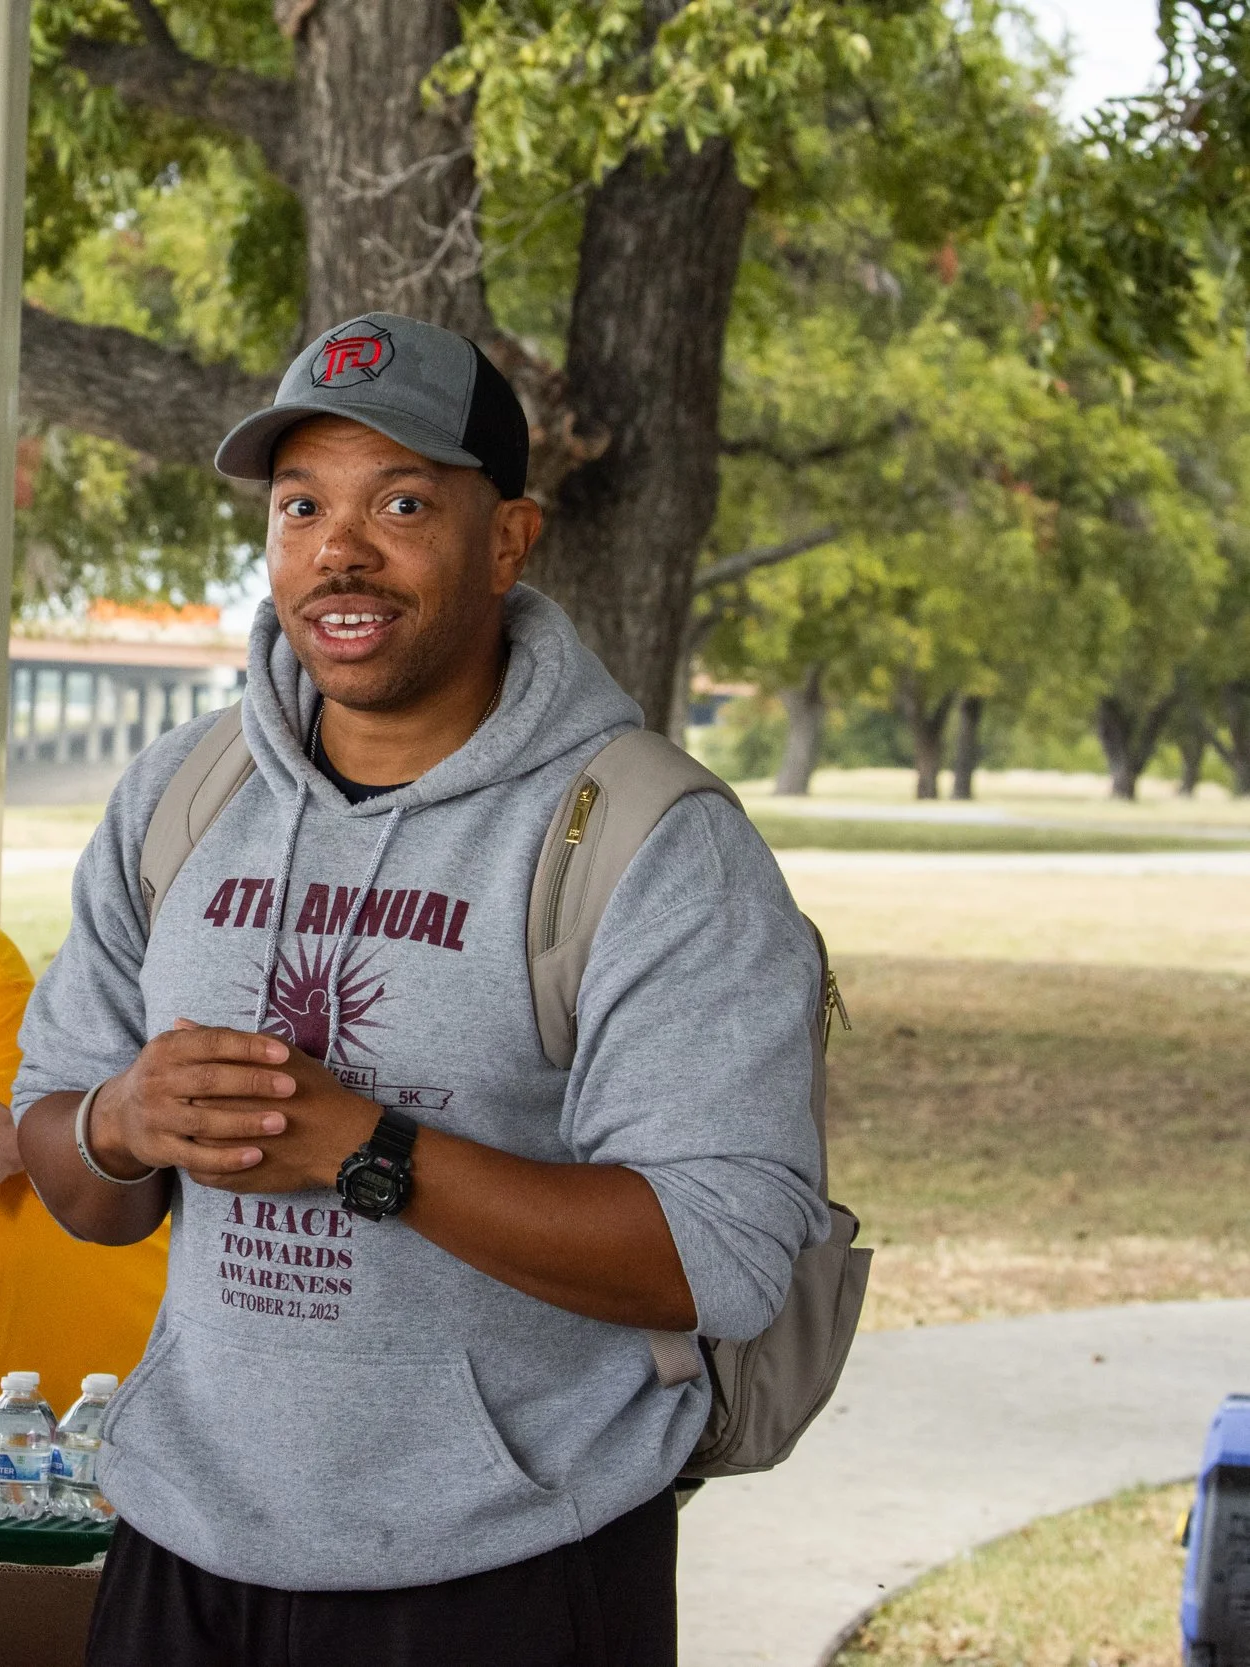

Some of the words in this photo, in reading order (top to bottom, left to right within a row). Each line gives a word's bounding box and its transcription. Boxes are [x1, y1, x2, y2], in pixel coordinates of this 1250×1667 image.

[203, 877, 290, 932] 4TH
[294, 883, 470, 952] ANNUAL
[339, 1069, 369, 1086] CELL
[398, 1090, 422, 1105] 5K
[223, 1195, 246, 1226] A
[253, 1200, 353, 1239] RACE
[220, 1231, 353, 1270] TOWARDS
[217, 1260, 353, 1296] AWARENESS
[221, 1287, 284, 1316] OCTOBER
[287, 1301, 306, 1321] 21,
[308, 1302, 340, 1321] 2023
